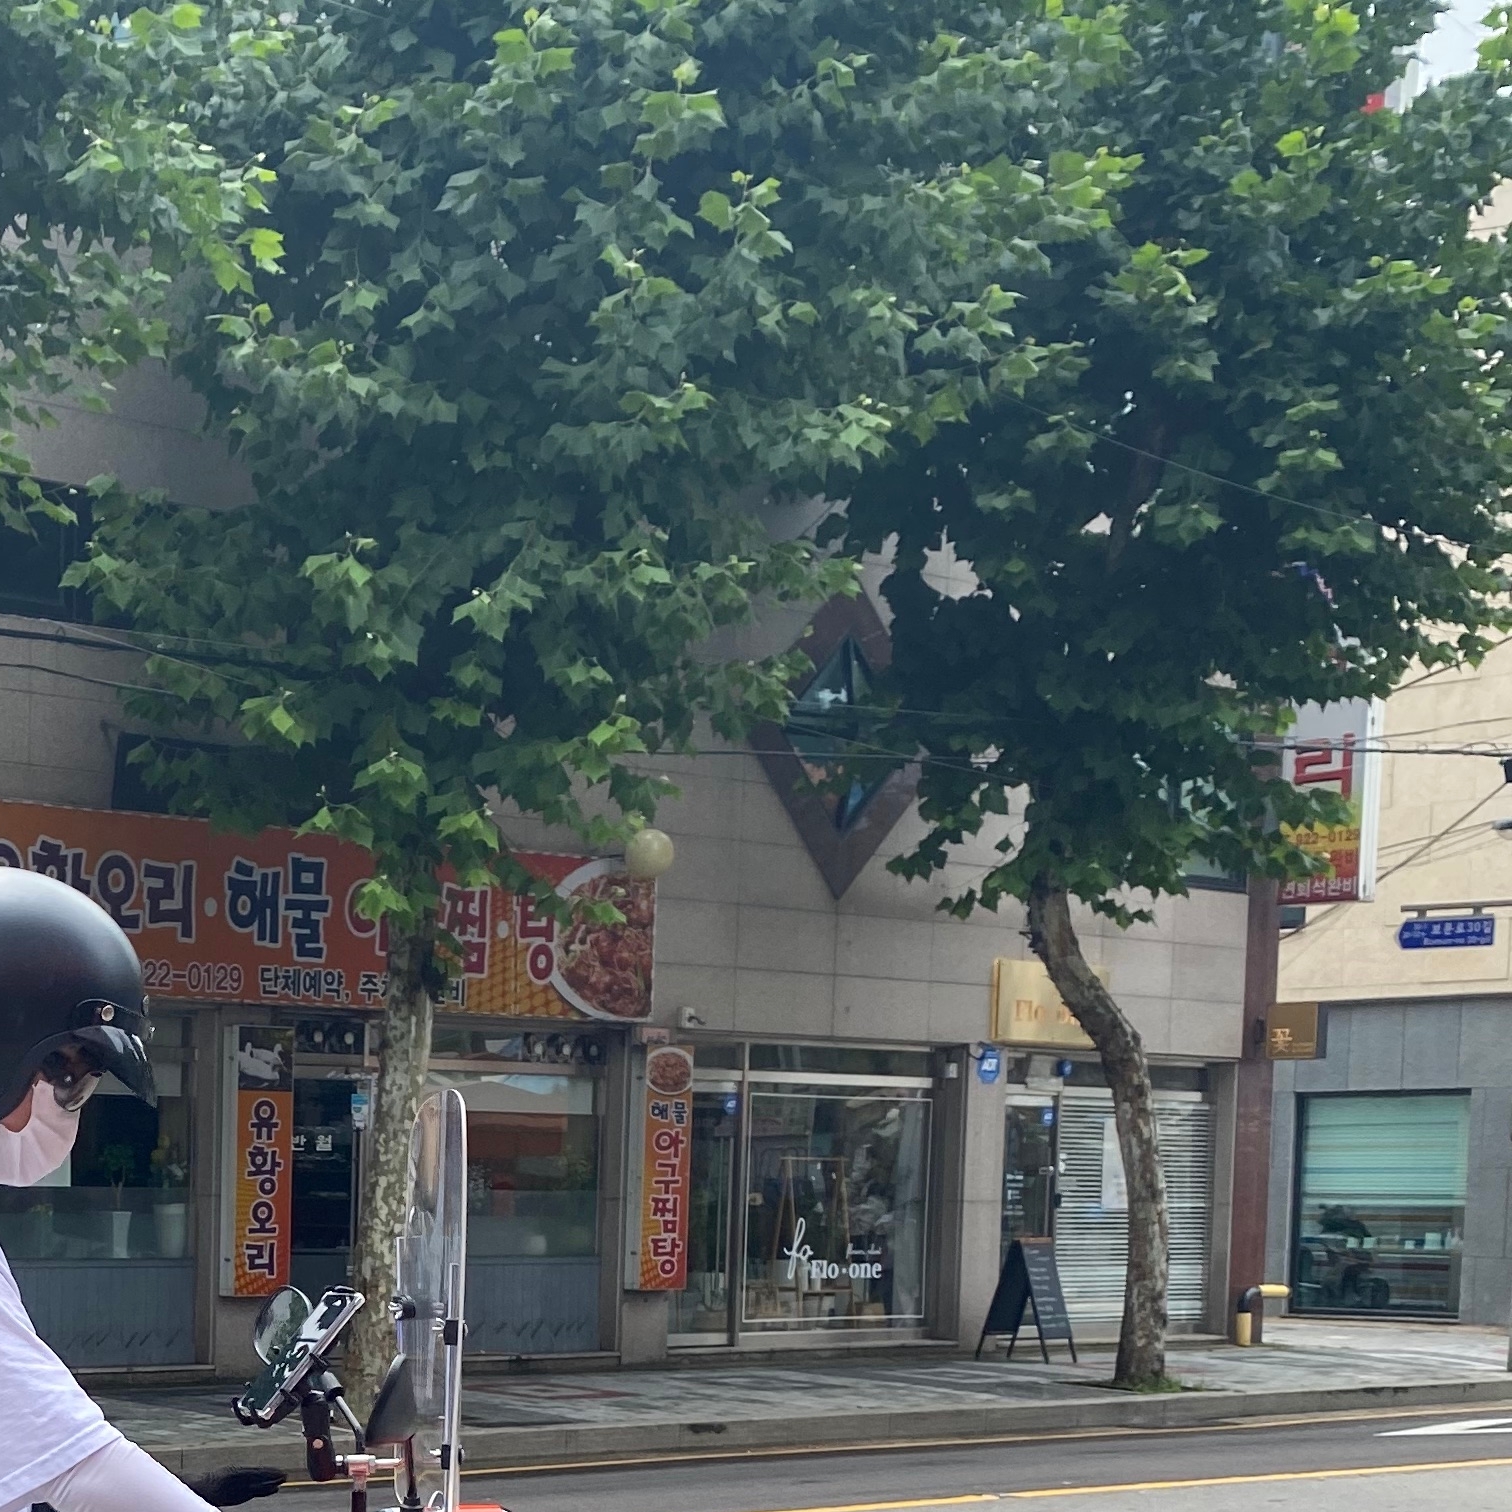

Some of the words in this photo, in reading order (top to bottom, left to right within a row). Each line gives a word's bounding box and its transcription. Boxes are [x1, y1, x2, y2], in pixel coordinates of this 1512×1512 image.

[143, 960, 244, 995] 22-0129
[650, 1100, 688, 1125] 해물
[245, 1097, 284, 1278] 유황오리
[649, 1129, 688, 1279] 아구찜탕
